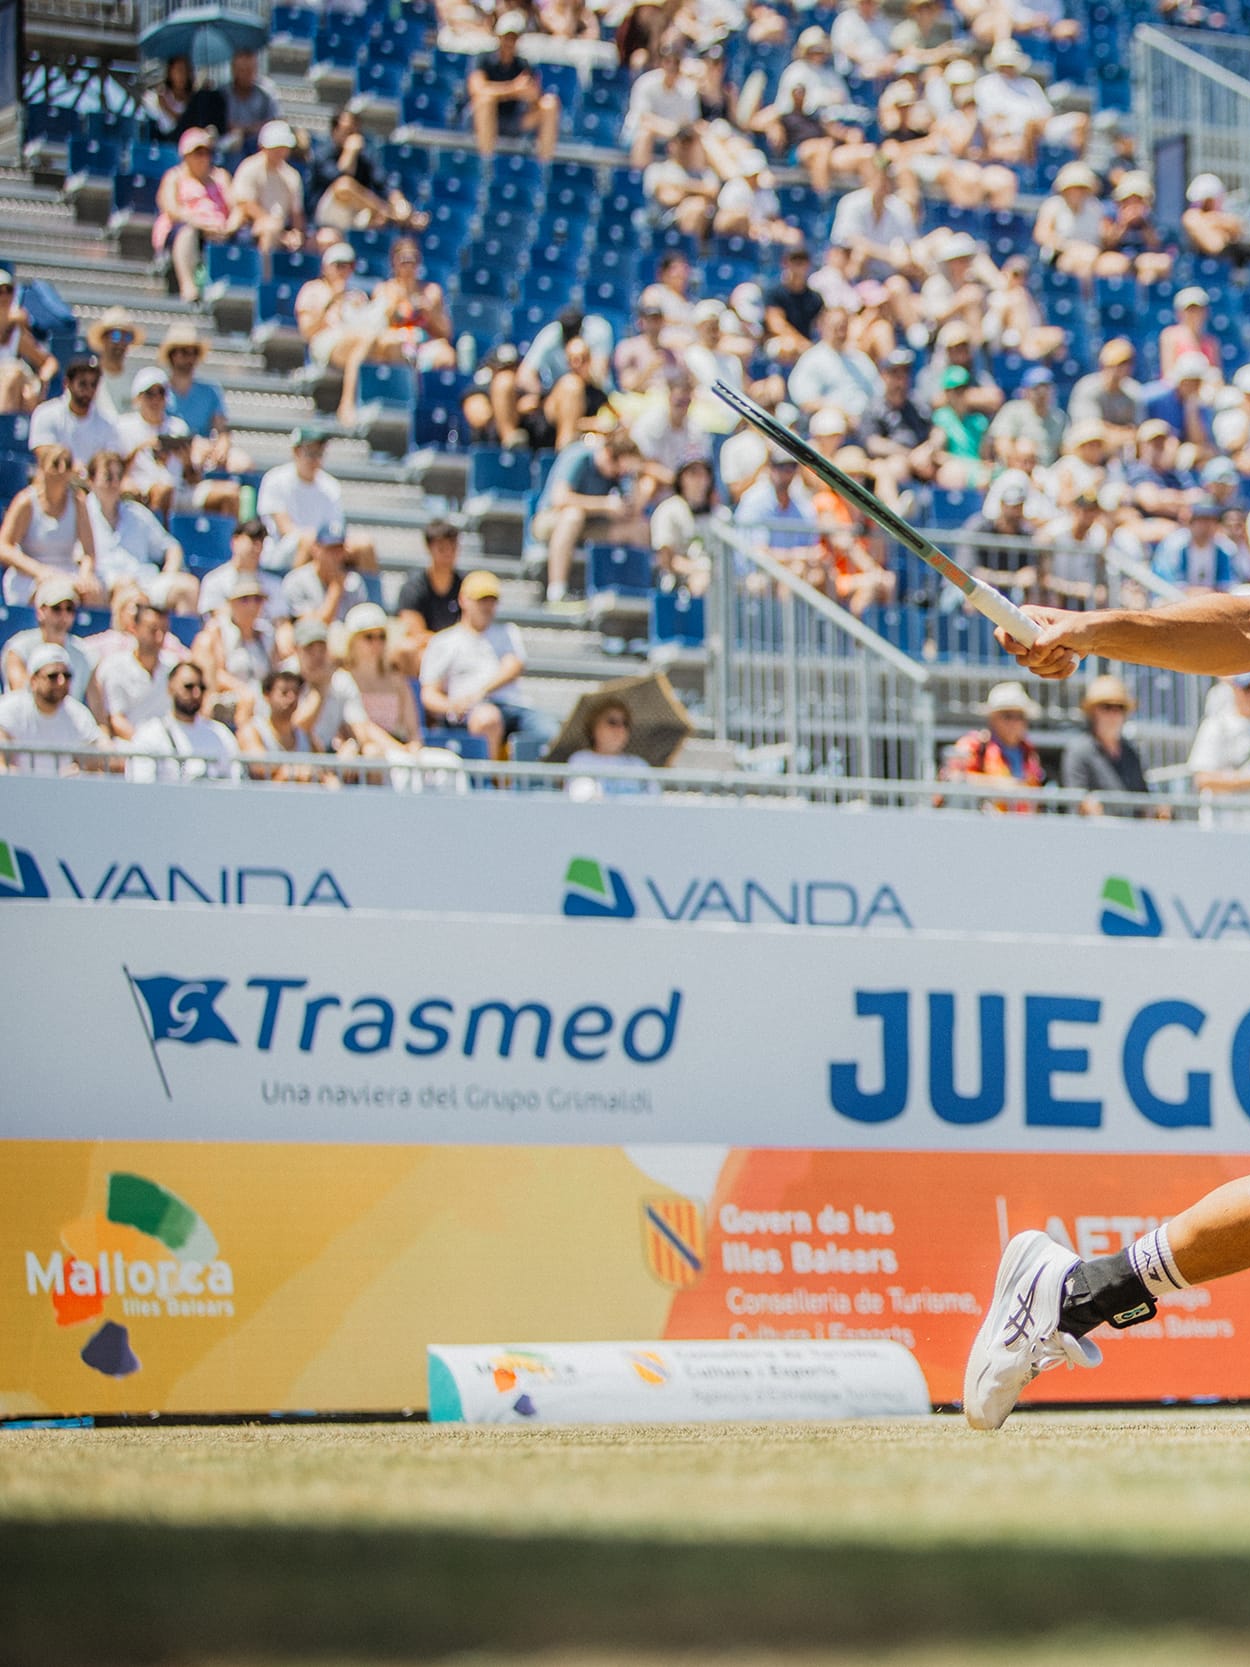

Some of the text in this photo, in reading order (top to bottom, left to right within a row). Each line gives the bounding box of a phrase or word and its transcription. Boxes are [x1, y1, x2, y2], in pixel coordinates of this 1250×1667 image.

[57, 857, 352, 908] VANDA
[645, 877, 913, 928] VANDA
[246, 976, 683, 1063] Trasmed
[261, 1080, 653, 1115] Una naviera del Grupo Grimaldi
[719, 1204, 895, 1234] Govern de les
[25, 1251, 234, 1295] Mallorca
[721, 1241, 898, 1274] Illes Balears
[123, 1299, 235, 1317] Illes Balears
[726, 1287, 850, 1315] Conselleria
[854, 1288, 884, 1315] de
